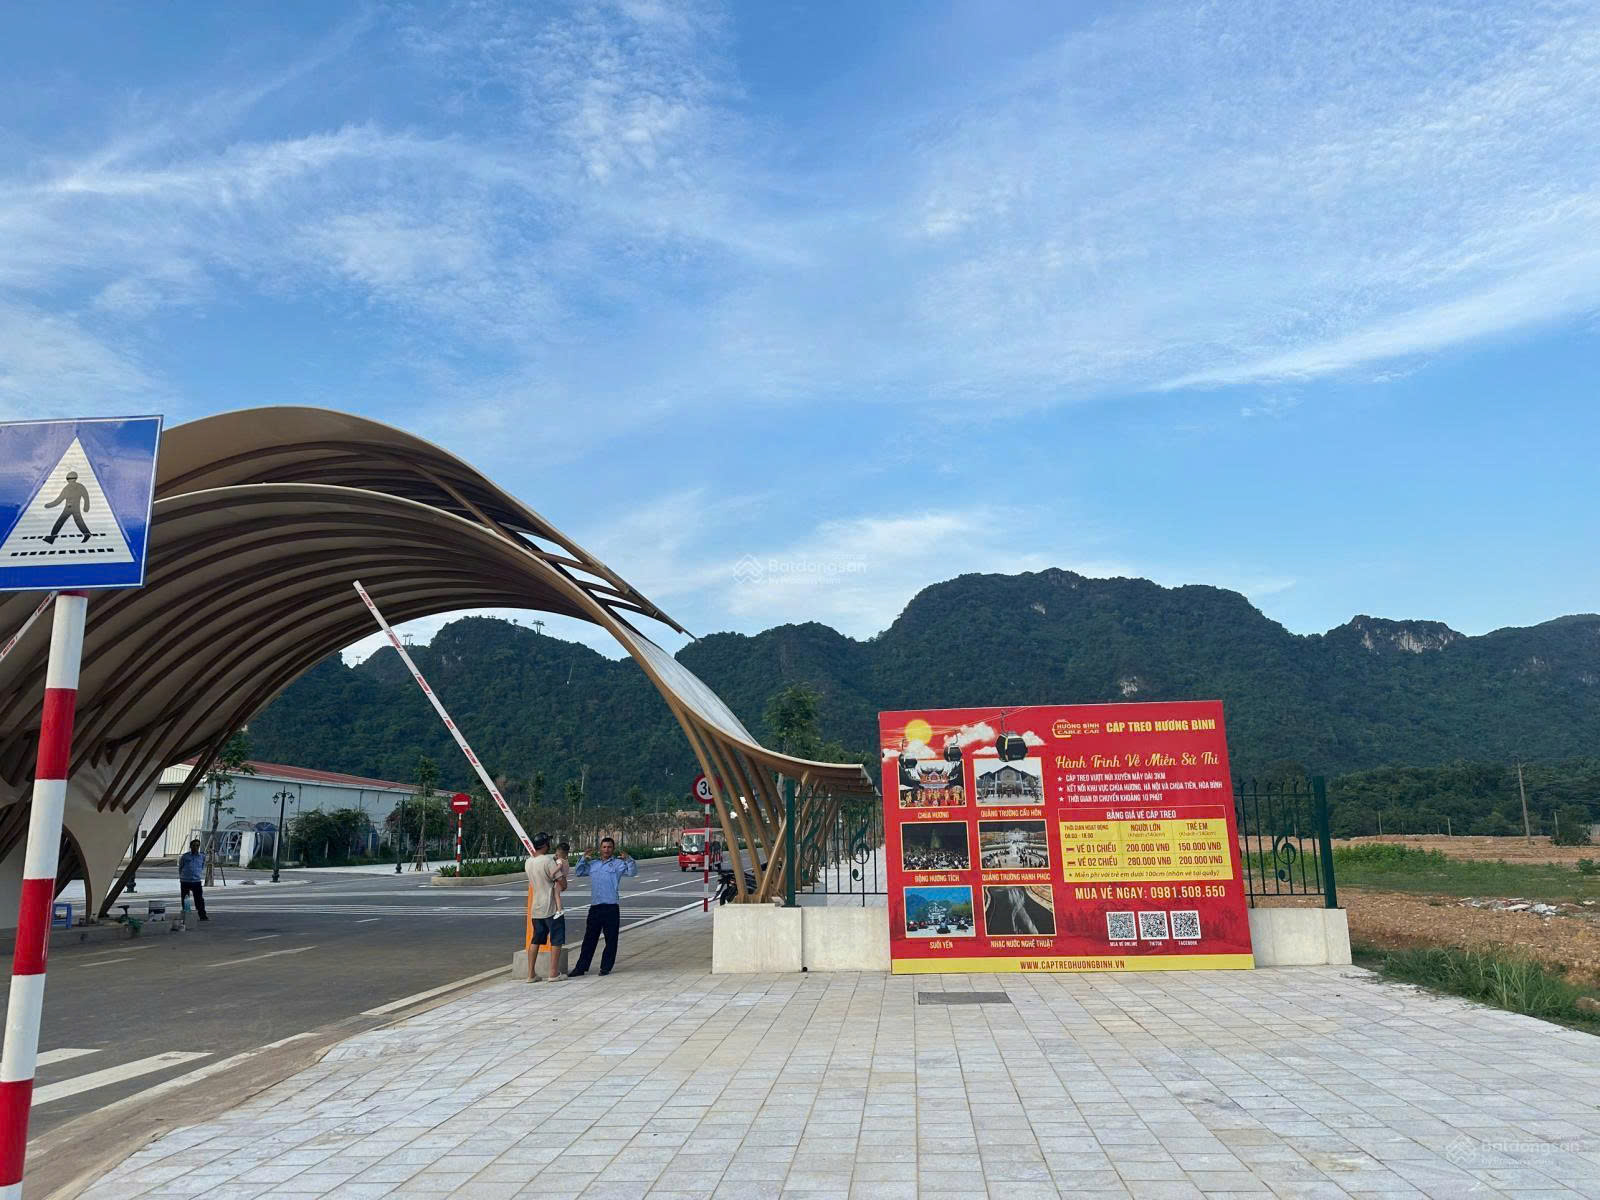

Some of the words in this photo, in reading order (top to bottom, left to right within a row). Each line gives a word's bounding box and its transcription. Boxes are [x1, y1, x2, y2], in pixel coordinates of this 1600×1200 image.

[1106, 720, 1126, 733] CÁP
[1128, 720, 1152, 732] TREO
[1154, 719, 1189, 732] HƯƠNG
[1191, 718, 1216, 730] BÌNH
[1055, 754, 1087, 769] Hành
[1090, 753, 1121, 768] Trình
[1124, 752, 1141, 767] Về
[1144, 752, 1177, 767] Miền
[1181, 751, 1198, 766] Sử
[1201, 750, 1219, 765] Thi
[1077, 774, 1090, 782] TREO
[1106, 809, 1124, 820] BẢNG
[1124, 809, 1135, 819] GIÁ
[1135, 809, 1145, 819] VÉ
[1145, 809, 1159, 819] CÁP
[1159, 810, 1177, 819] TREO
[1198, 822, 1208, 830] EM
[1076, 842, 1085, 853] VÉ
[1086, 844, 1095, 853] 01
[1126, 843, 1155, 853] 200.000
[1155, 842, 1170, 852] VNĐ
[1178, 842, 1206, 851] 150.000
[1206, 841, 1222, 851] VNĐ
[1077, 856, 1086, 867] VÉ
[1087, 857, 1097, 867] 02
[1127, 856, 1156, 866] 280.000
[1156, 856, 1172, 865] VNĐ
[1179, 855, 1208, 865] 200.000
[1208, 855, 1223, 864] VNĐ
[1074, 886, 1098, 900] MUA
[1100, 884, 1114, 899] VÉ
[1116, 886, 1148, 899] NGAY:
[1150, 885, 1226, 899] 0981.508.550
[1019, 959, 1125, 970] WWW.CAPTREOHUONGBINH.VN
